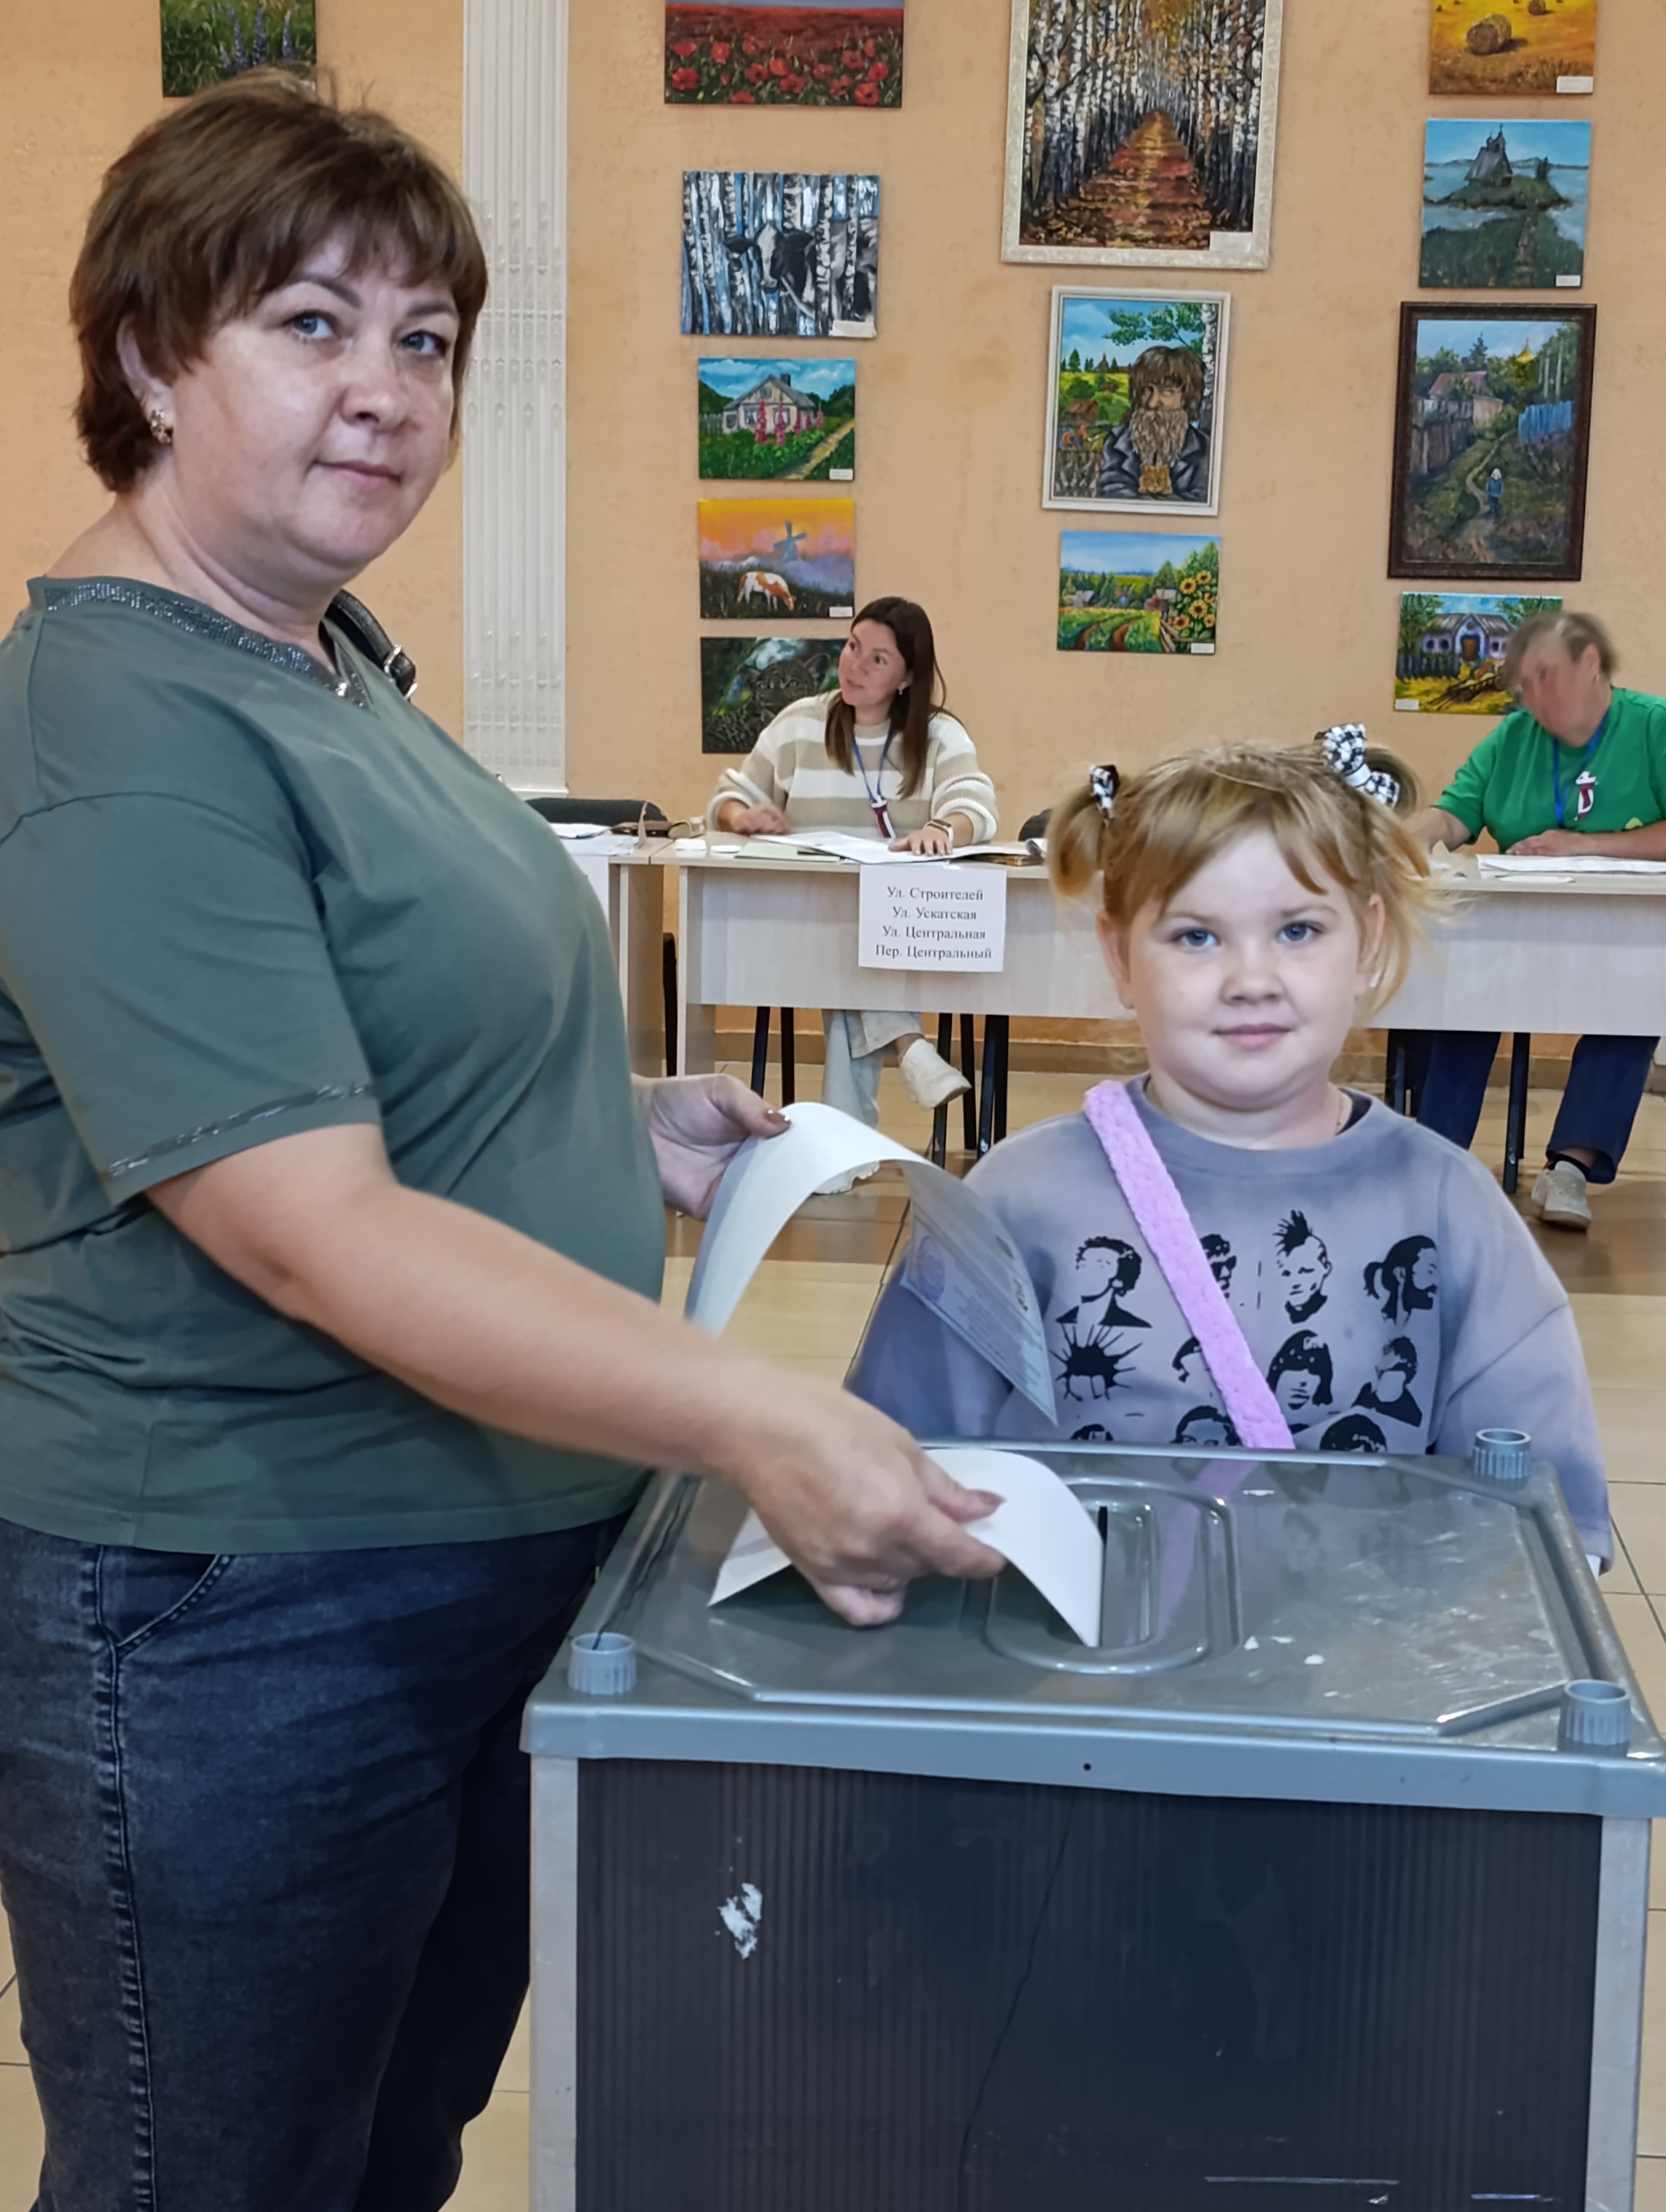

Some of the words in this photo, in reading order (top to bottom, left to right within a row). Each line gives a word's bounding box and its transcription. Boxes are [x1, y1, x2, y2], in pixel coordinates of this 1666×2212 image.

[887, 886, 905, 898] Ул.
[909, 888, 983, 902] Строителей
[893, 906, 911, 918] Ул.
[916, 907, 977, 920] Ускатская
[882, 925, 901, 938] Ул.
[906, 926, 986, 941] Центральная
[876, 944, 902, 959] Пер.
[907, 946, 992, 961] Центральный
